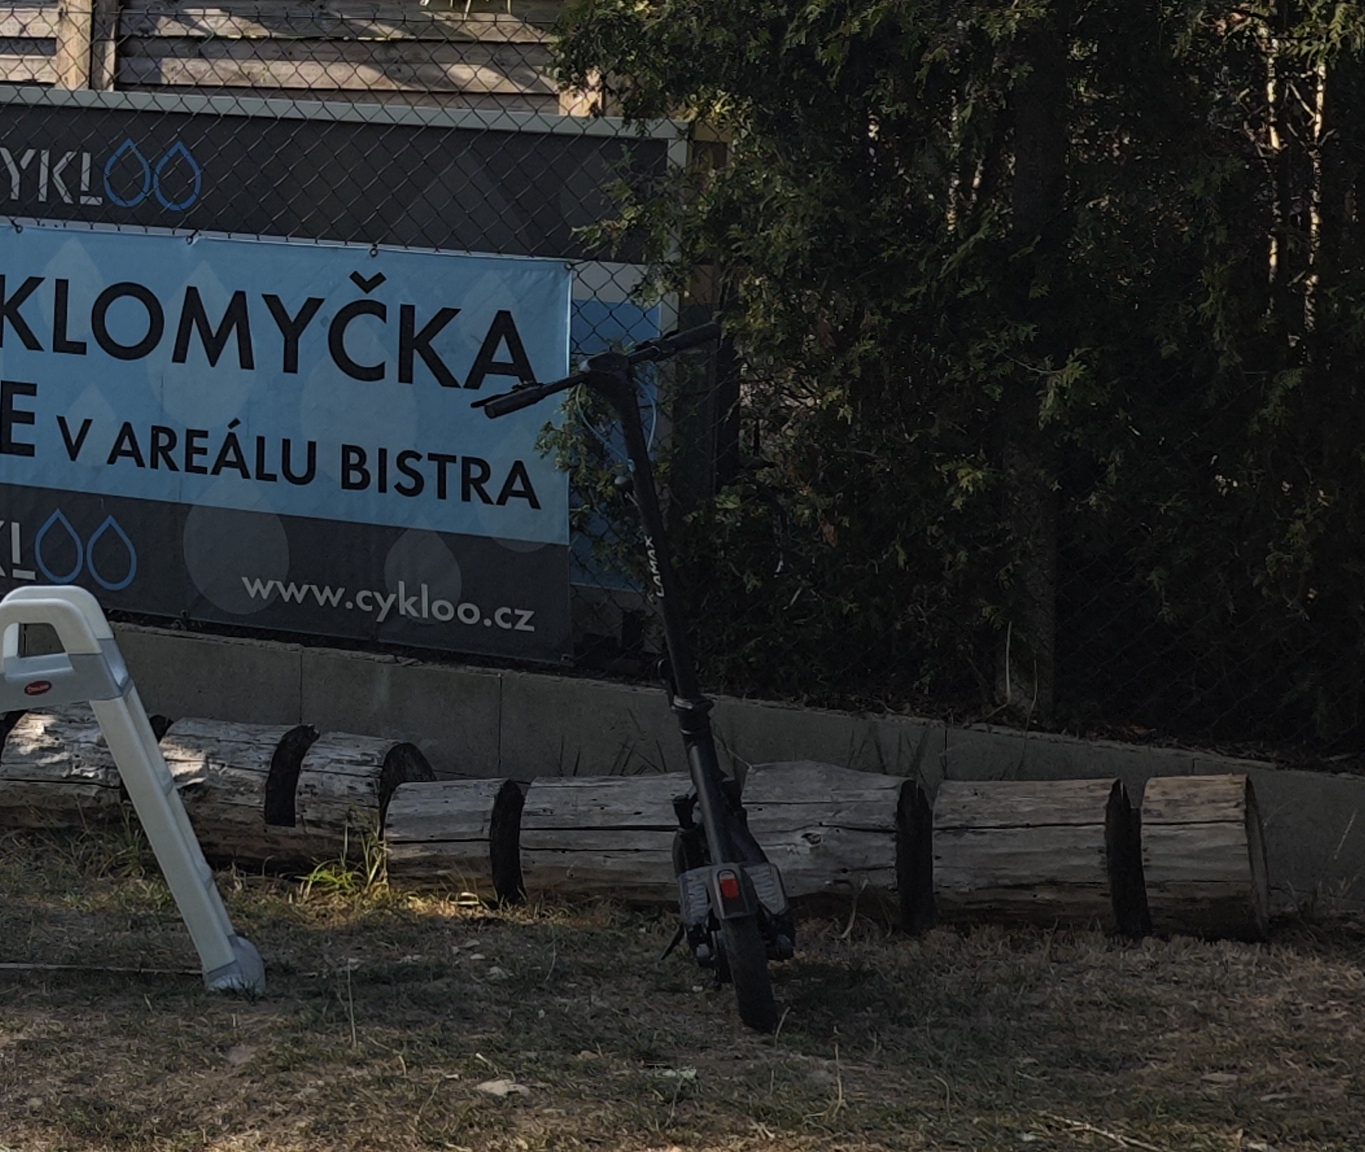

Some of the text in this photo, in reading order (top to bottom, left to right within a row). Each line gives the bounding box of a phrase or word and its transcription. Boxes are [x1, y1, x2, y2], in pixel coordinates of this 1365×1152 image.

[56, 414, 92, 462] V
[106, 417, 317, 486] AREÁLU
[340, 443, 542, 510] BISTRA
[241, 576, 536, 632] www.cykloo.cz
